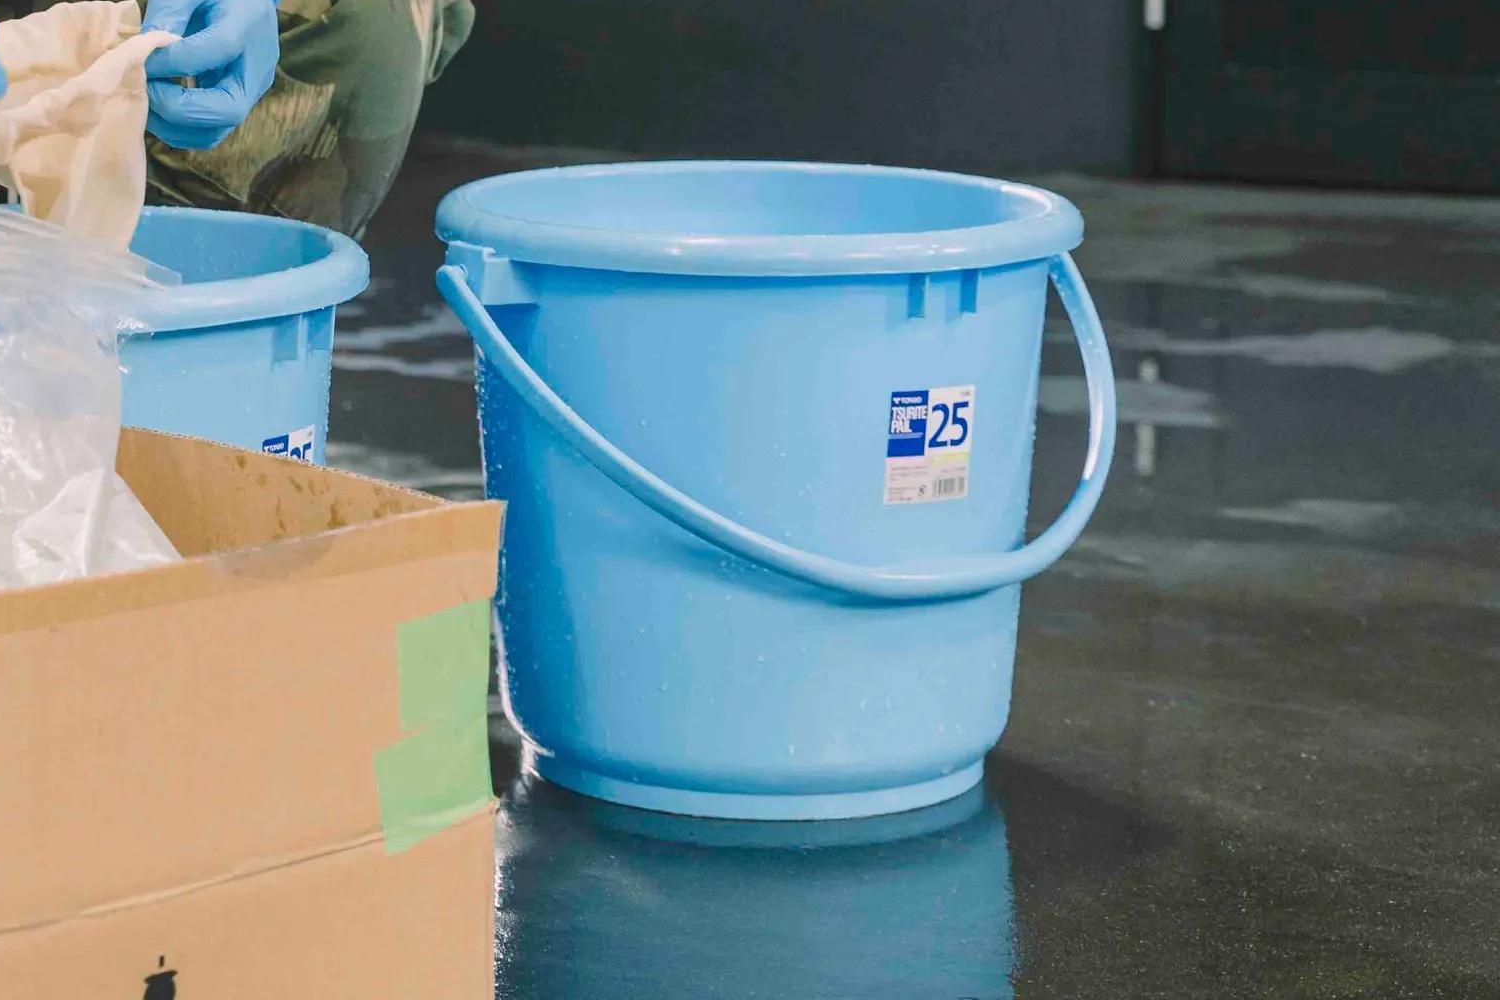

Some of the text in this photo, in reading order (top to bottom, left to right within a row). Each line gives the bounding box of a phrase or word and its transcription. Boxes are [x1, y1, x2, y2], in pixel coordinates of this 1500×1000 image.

[891, 405, 927, 420] TSURITE
[891, 419, 912, 433] PAIL
[928, 401, 969, 448] 25
